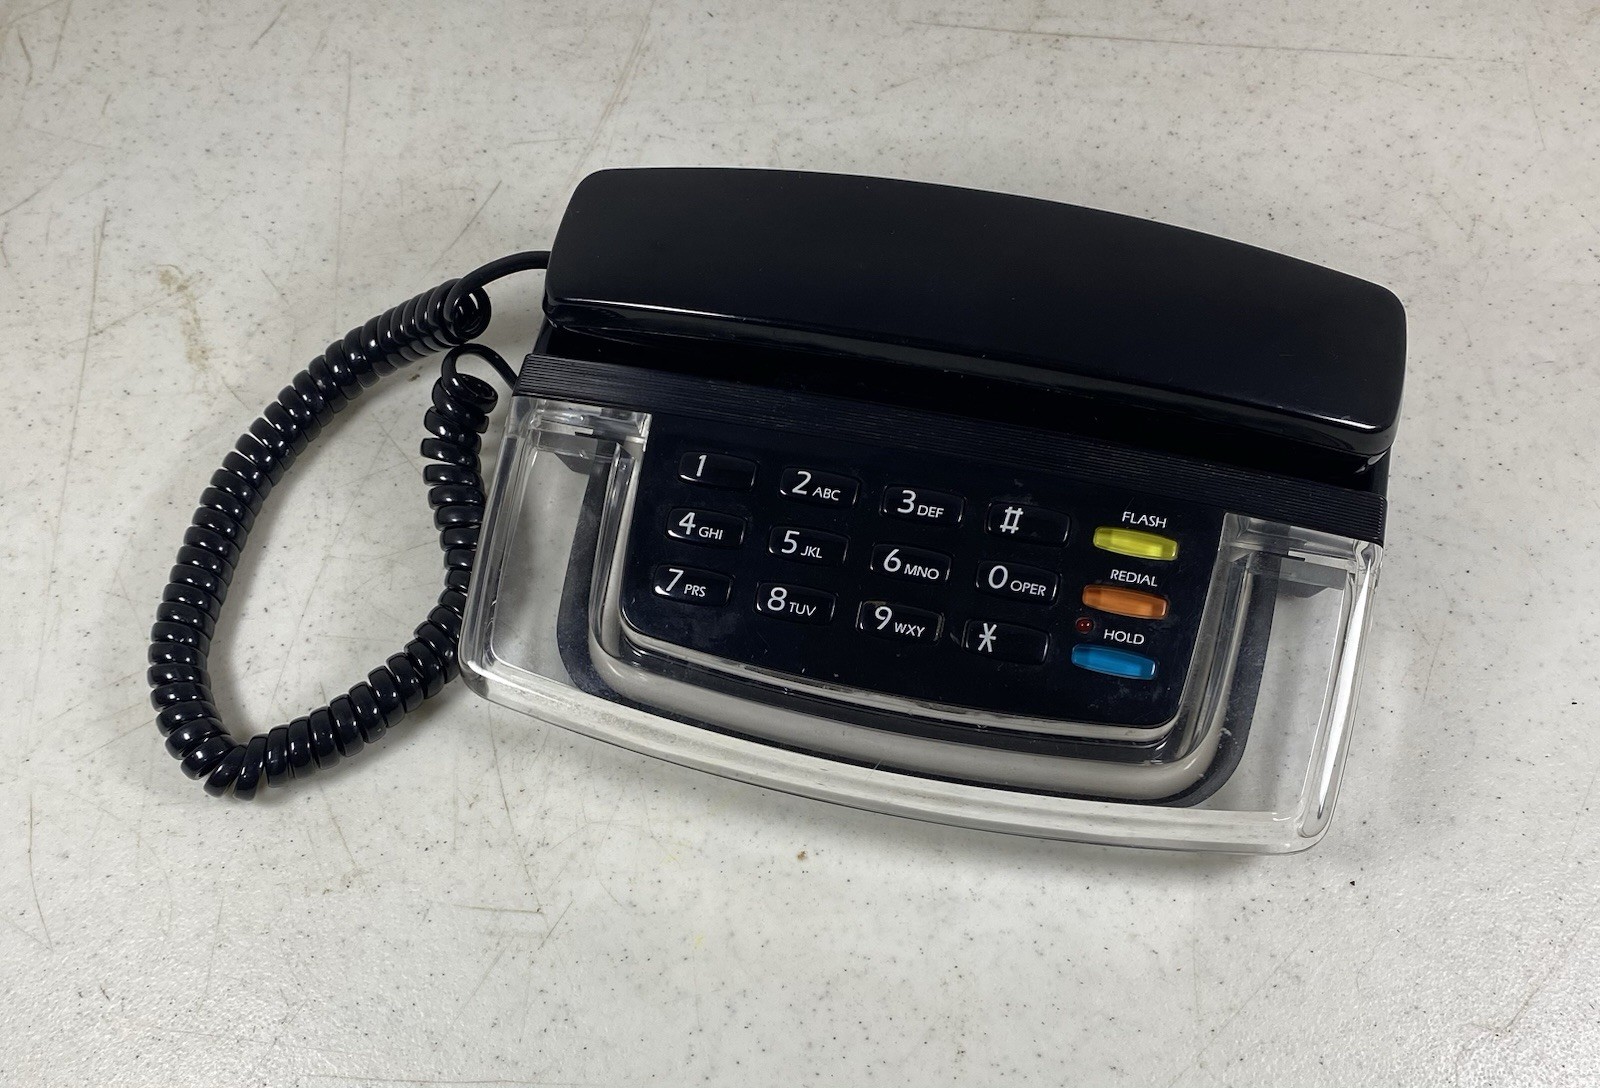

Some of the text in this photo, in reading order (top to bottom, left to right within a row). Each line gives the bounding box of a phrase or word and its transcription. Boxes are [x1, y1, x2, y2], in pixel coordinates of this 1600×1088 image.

[696, 454, 707, 477] 1
[791, 470, 841, 501] 2 ABC
[897, 489, 945, 518] 3 DEF
[678, 511, 724, 540] 4 GHI
[1000, 506, 1024, 534] #
[1121, 511, 1167, 529] FLASH
[781, 529, 823, 559] 5 JKL
[883, 548, 940, 580] 6 MNO
[1110, 569, 1158, 587] REDIAL
[665, 568, 707, 598] 7 PRS
[988, 565, 1047, 597] 0 OPER
[767, 586, 817, 617] 8 TUV
[874, 606, 926, 638] 9 WXY
[1103, 628, 1145, 645] HOLD
